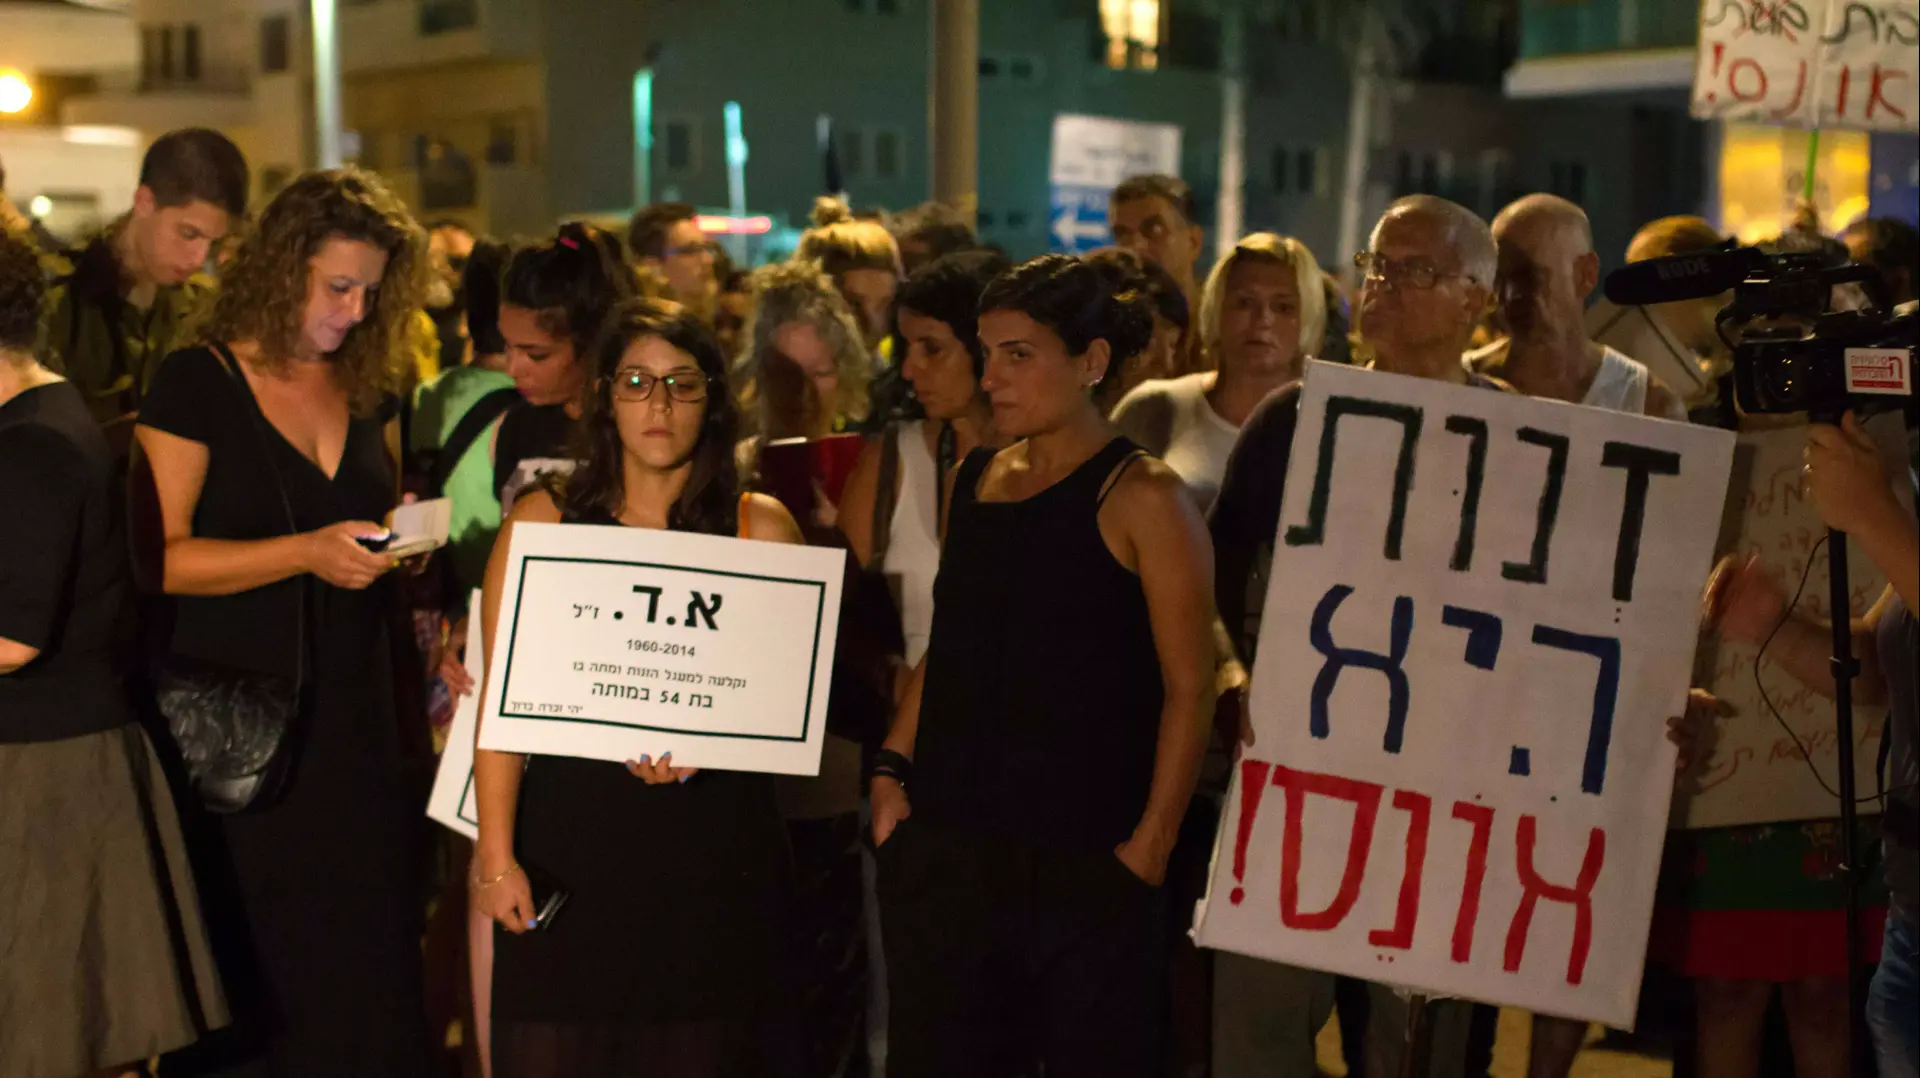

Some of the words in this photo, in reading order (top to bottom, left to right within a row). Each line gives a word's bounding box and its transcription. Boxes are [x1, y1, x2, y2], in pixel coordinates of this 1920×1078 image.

[1706, 41, 1909, 120] אונס!
[626, 638, 696, 658] 1960-2014
[573, 661, 585, 672] בו
[589, 662, 622, 675] ומתה
[626, 667, 660, 679] הזנות
[664, 669, 703, 684] למעגל
[707, 675, 747, 690] נקלעה
[591, 682, 651, 702] במותה
[659, 690, 680, 705] 54
[688, 693, 713, 709] בת
